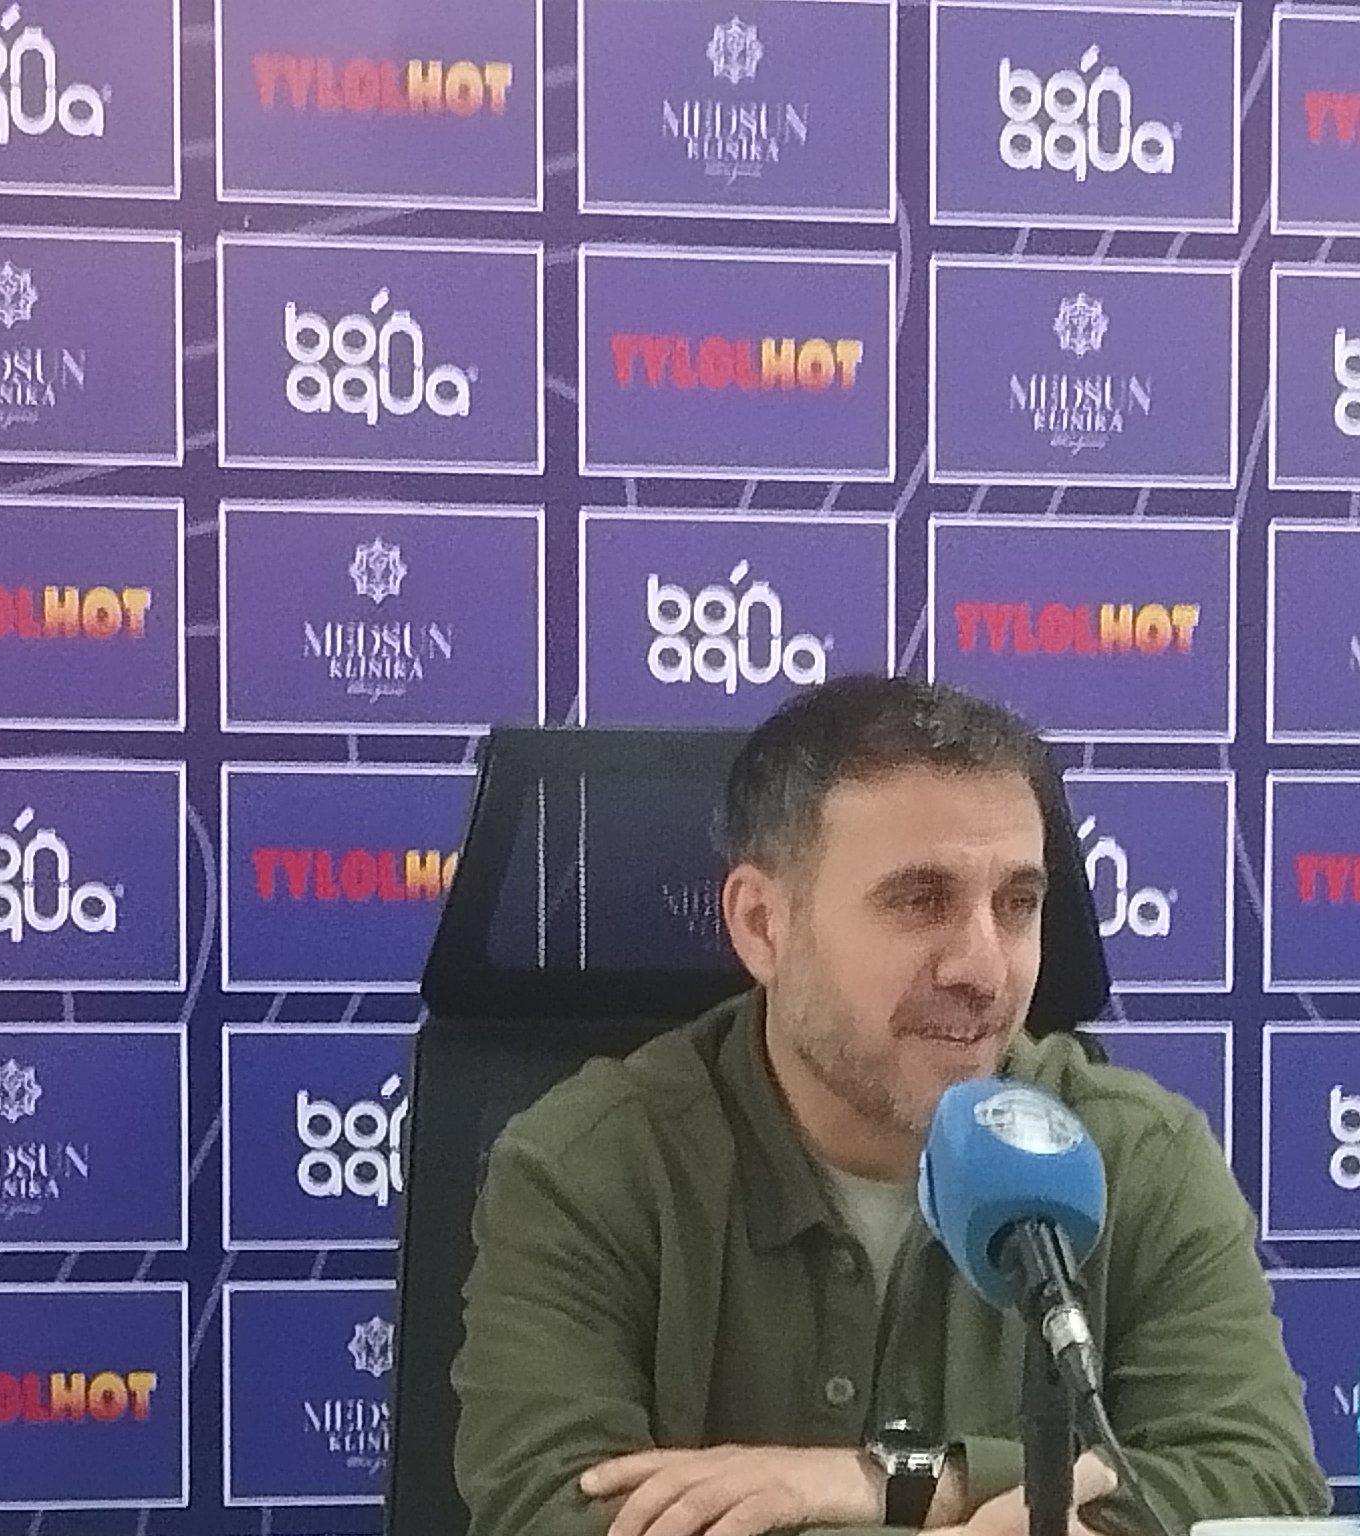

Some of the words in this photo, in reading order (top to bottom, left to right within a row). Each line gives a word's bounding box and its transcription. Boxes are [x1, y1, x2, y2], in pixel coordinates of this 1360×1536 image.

[999, 45, 1131, 121] bón
[1000, 120, 1176, 181] aqua
[285, 287, 423, 365] bón
[286, 363, 472, 425] aqua
[647, 560, 782, 636] bón
[648, 635, 829, 694] aqua
[252, 848, 458, 900] TYLOLH
